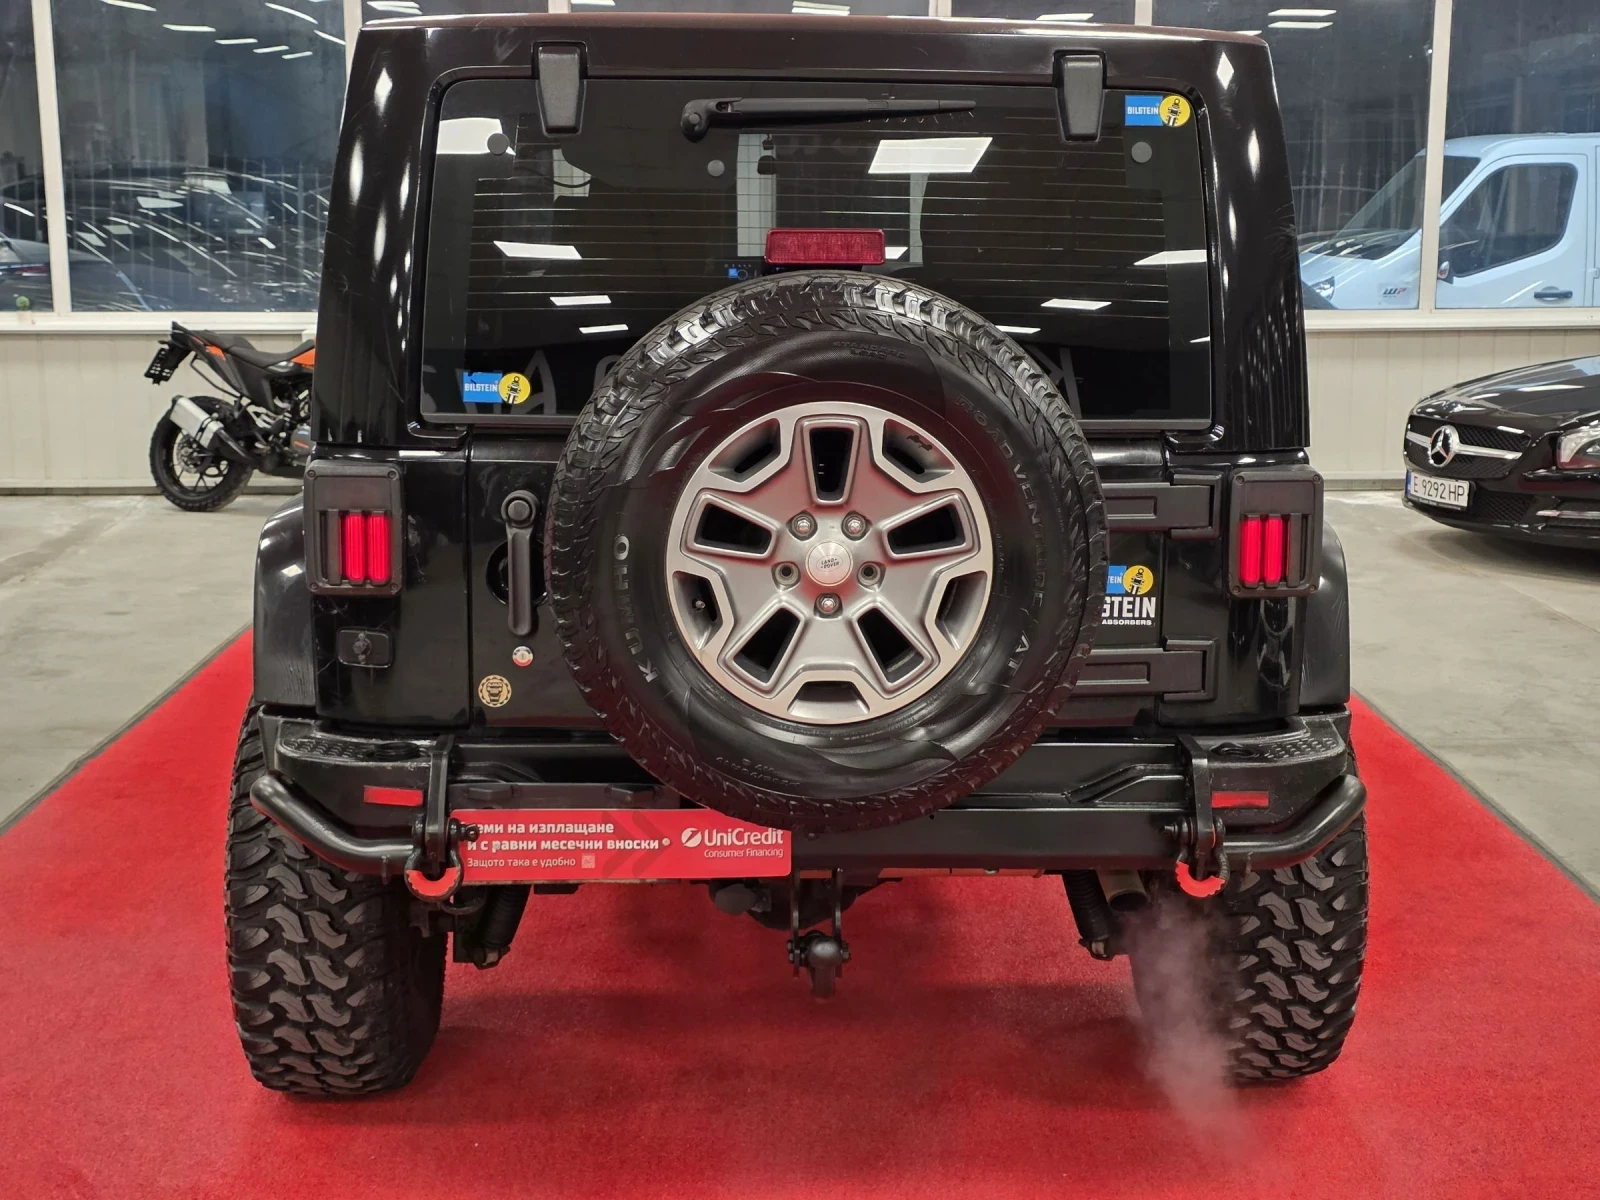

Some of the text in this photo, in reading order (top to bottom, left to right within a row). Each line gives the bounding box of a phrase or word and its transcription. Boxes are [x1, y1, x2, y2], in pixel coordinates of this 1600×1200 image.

[1127, 106, 1159, 115] BILSTEIN
[464, 383, 498, 392] BILSTEIN
[1413, 475, 1465, 502] E 9292 HP
[1107, 575, 1122, 584] TEIN
[613, 533, 659, 683] KUMHO
[1101, 596, 1156, 618] STEIN
[1101, 618, 1152, 626] ABSORBERS
[507, 823, 526, 834] на
[529, 823, 614, 836] изплащане
[704, 827, 784, 846] UniCredit
[480, 840, 489, 851] с
[491, 840, 537, 853] равни
[541, 839, 603, 850] месечни
[607, 838, 659, 850] вноски
[704, 847, 784, 859] Consumer Financing
[467, 856, 576, 869] Защото така е удобно
